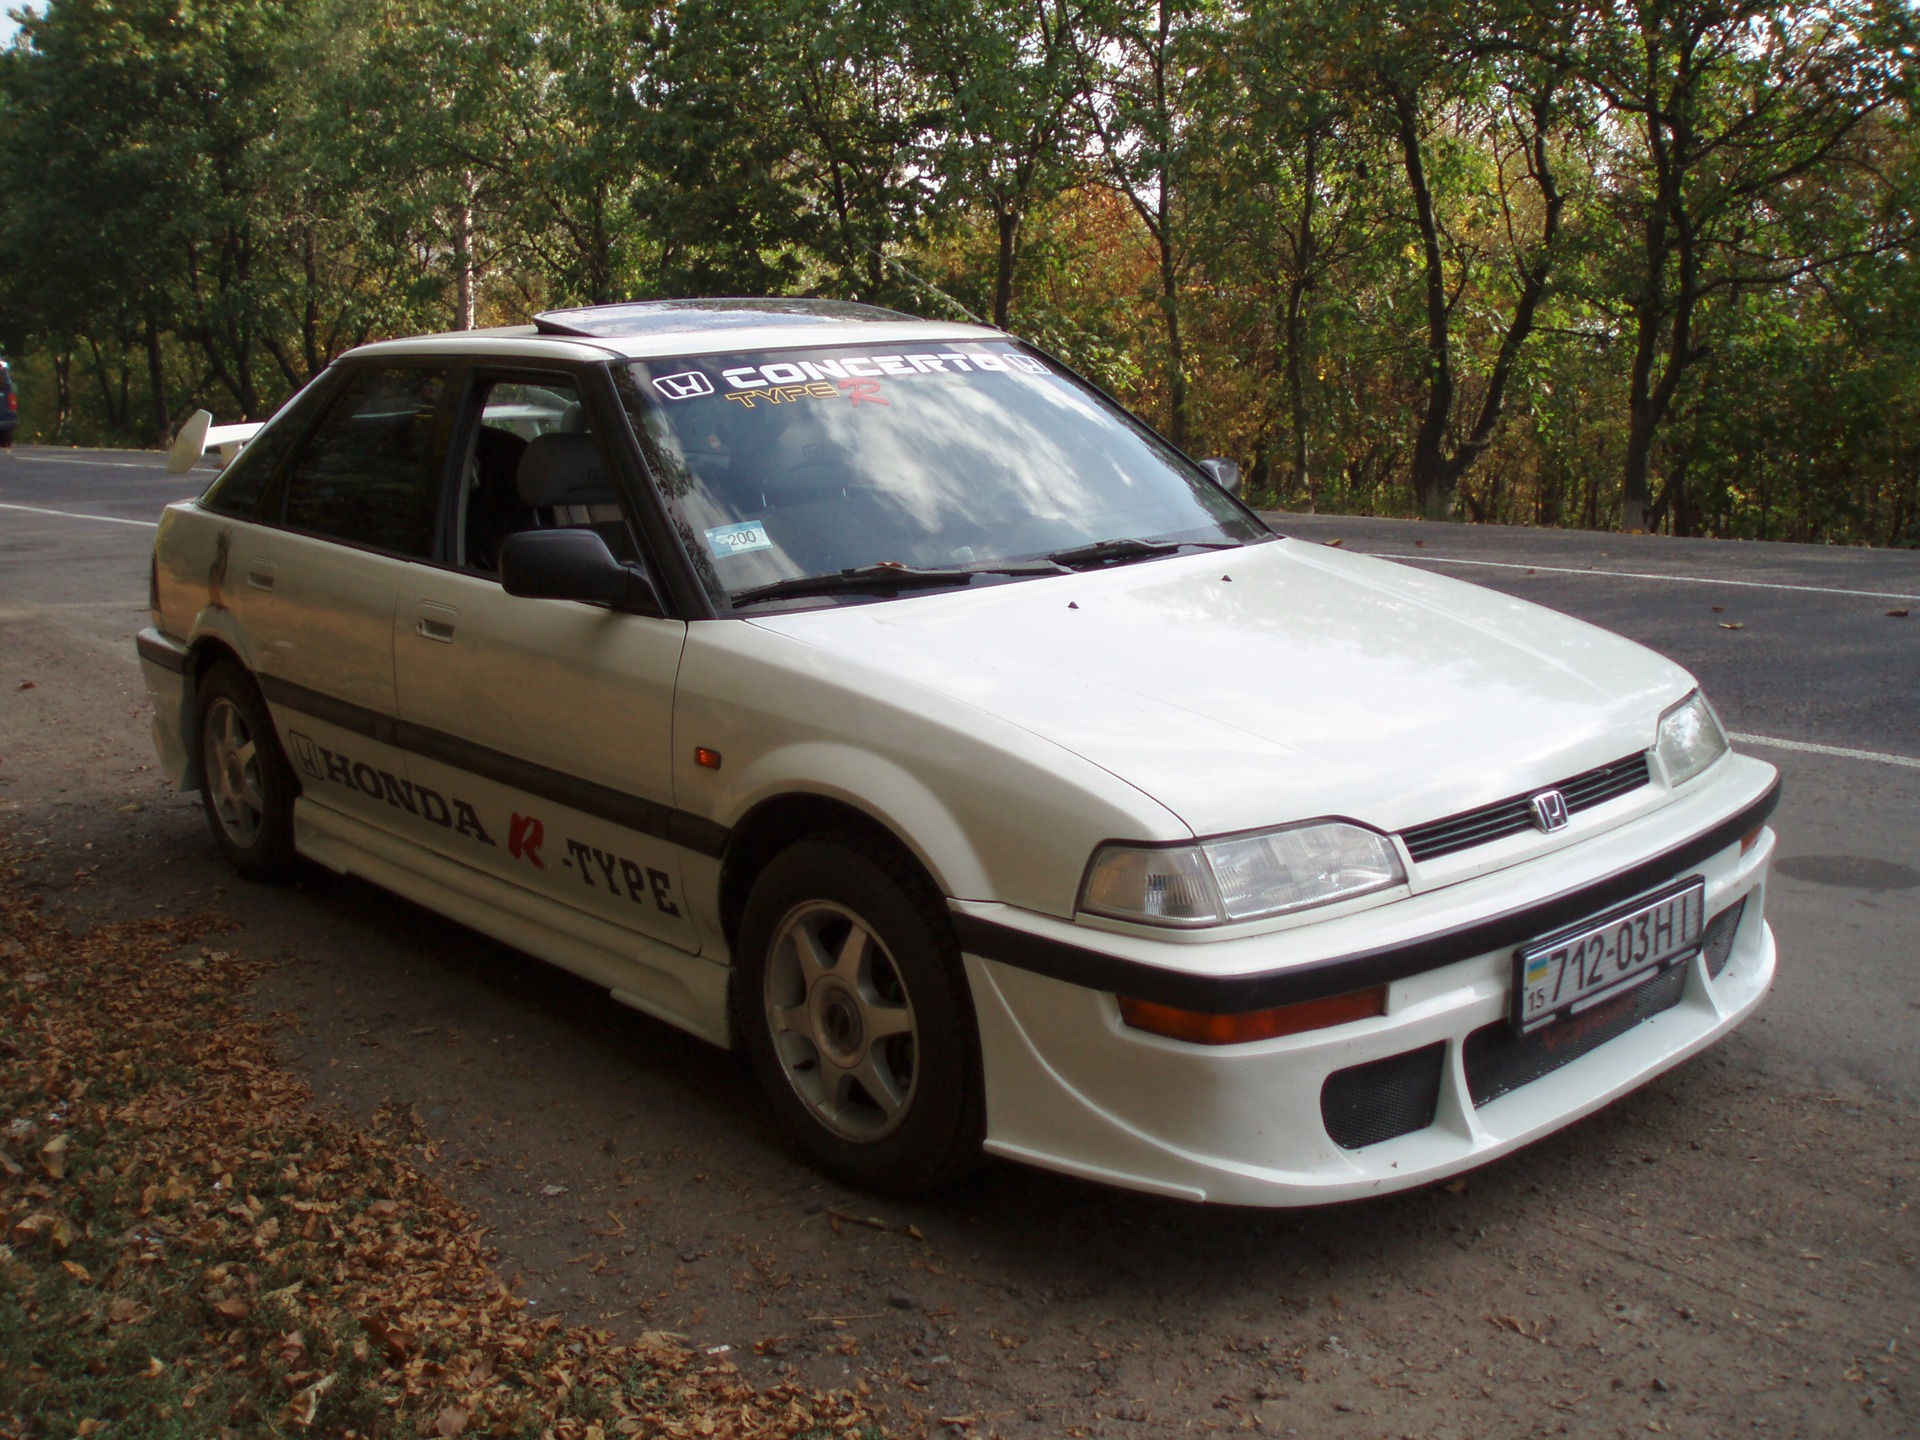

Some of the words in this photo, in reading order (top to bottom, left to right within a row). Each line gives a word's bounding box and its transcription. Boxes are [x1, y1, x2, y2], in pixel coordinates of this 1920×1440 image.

[721, 353, 1011, 388] CONCERTO
[725, 382, 840, 408] TYPE
[838, 376, 890, 407] R
[318, 747, 496, 846] HONDA
[508, 812, 544, 869] R
[1528, 987, 1545, 1012] 15
